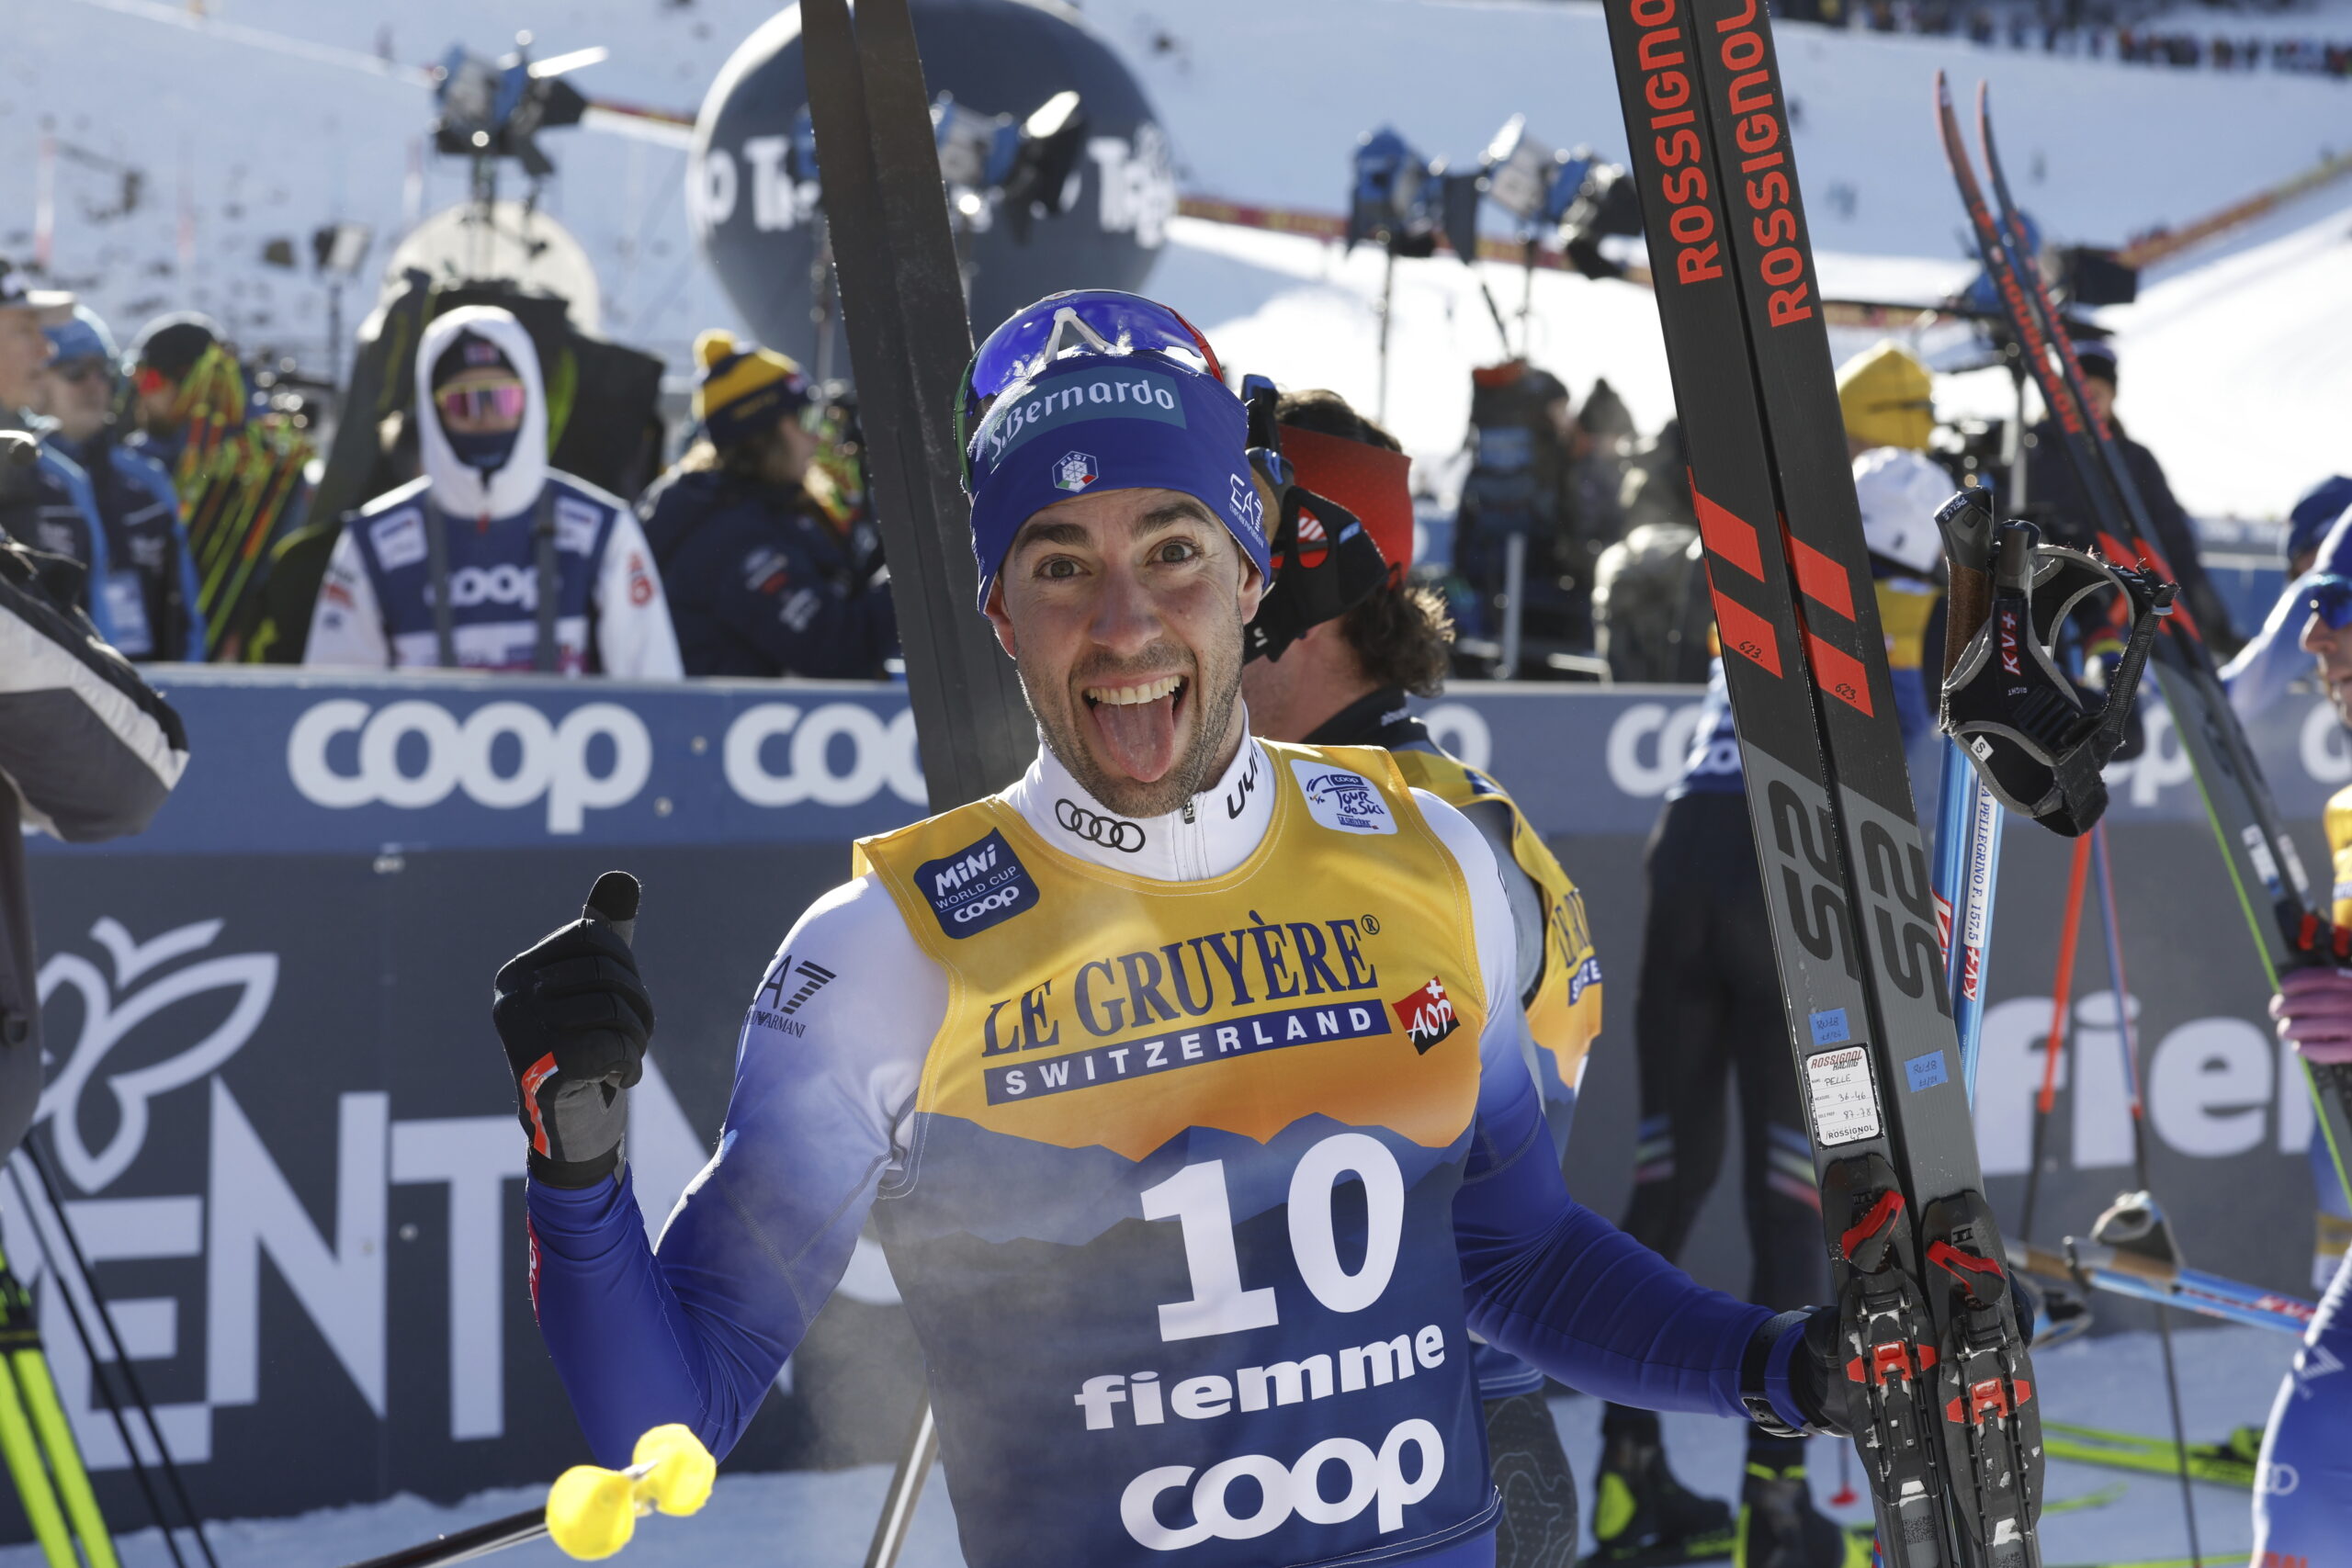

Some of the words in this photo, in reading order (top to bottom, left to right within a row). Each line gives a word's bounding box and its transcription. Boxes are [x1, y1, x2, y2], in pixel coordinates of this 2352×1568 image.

[1630, 0, 1724, 285] ROSSIGNO
[1716, 0, 1813, 327] ROSSIGNOL
[1060, 454, 1088, 467] FISI
[287, 698, 652, 834] coop
[1973, 800, 1990, 885] PELLEGRINO
[935, 883, 986, 909] WORLD
[989, 865, 1017, 886] CUP
[954, 886, 1020, 922] coop
[1967, 903, 1982, 941] 157,5
[764, 1011, 807, 1038] ARMANI
[981, 978, 1059, 1057] LE
[1407, 998, 1453, 1043] AOP
[1005, 1007, 1372, 1095] SWITZERLAND
[1811, 1049, 1863, 1070] ROSSIGNOL
[1825, 1074, 1852, 1087] PELLE
[1827, 1124, 1875, 1139] ROSSIGNOL
[1139, 1133, 1406, 1343] 10
[1073, 1324, 1445, 1431] fiemme
[1119, 1417, 1445, 1551] coop
